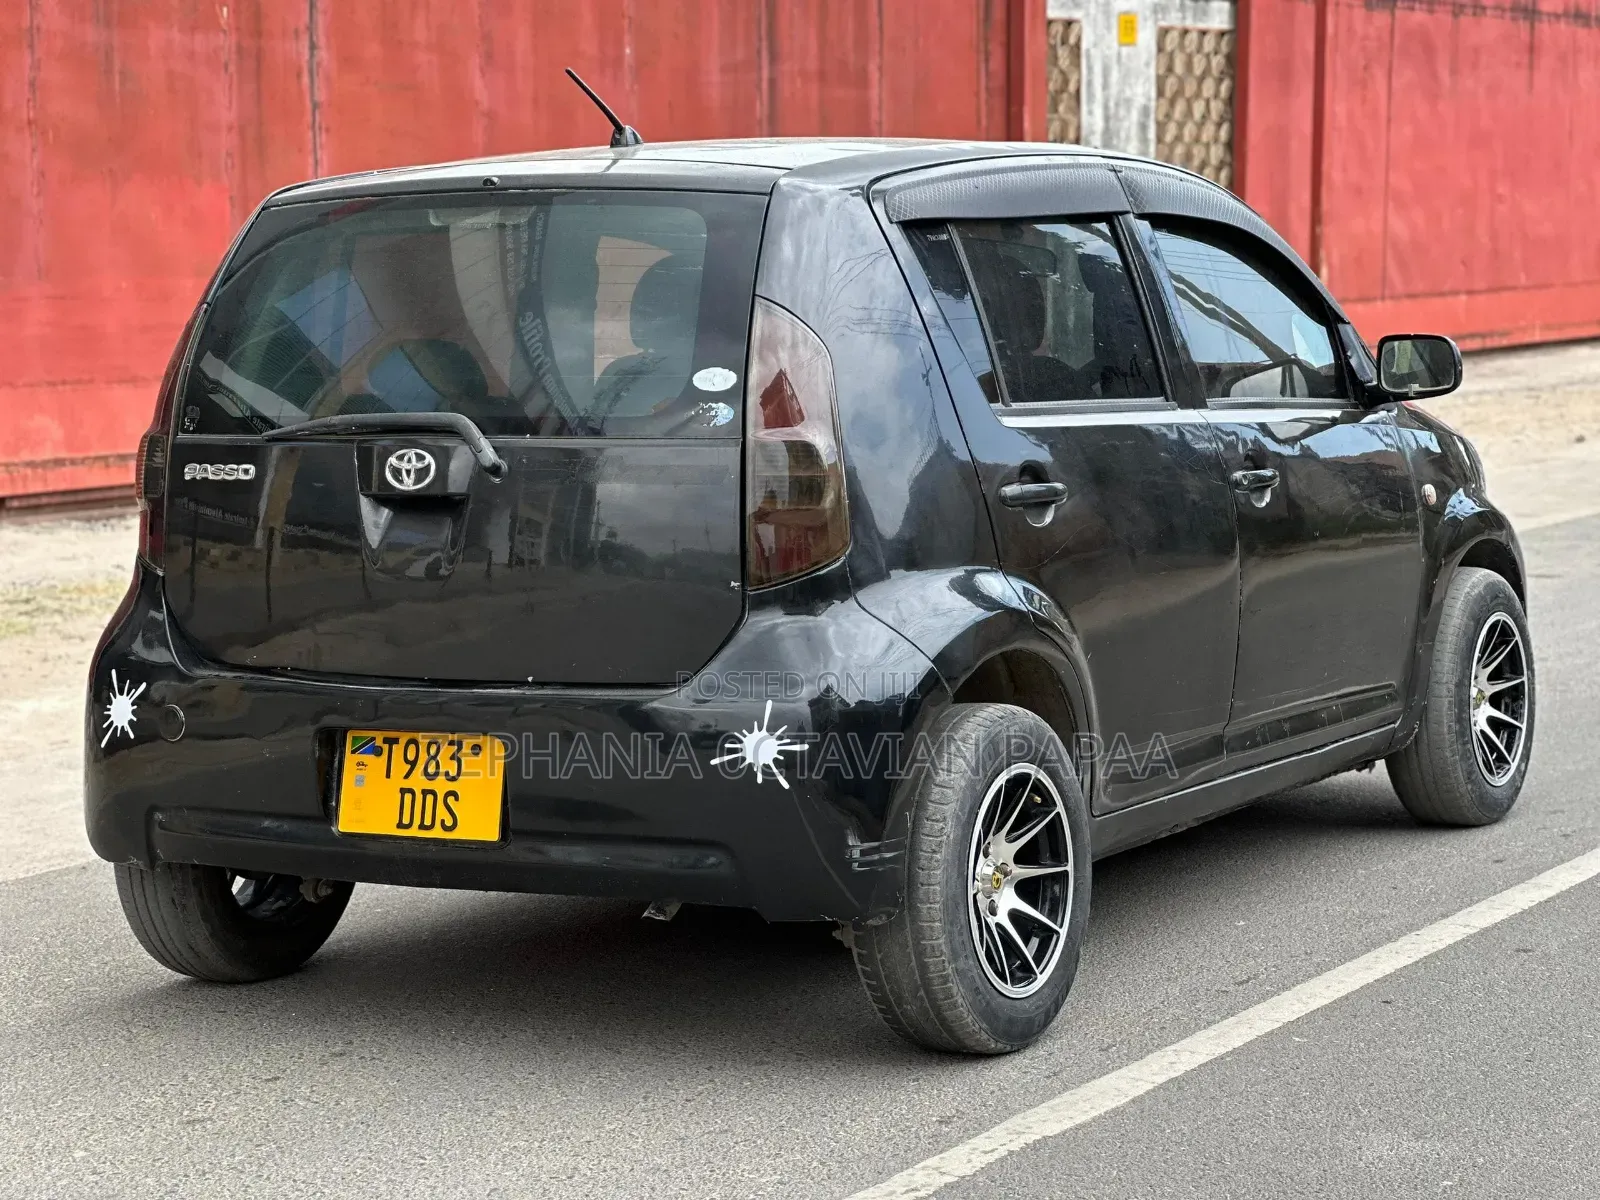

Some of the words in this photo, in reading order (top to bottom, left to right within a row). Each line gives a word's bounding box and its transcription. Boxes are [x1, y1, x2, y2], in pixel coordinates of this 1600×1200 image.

[184, 463, 256, 480] PASSO
[382, 737, 464, 782] T983
[396, 787, 460, 832] DDS
